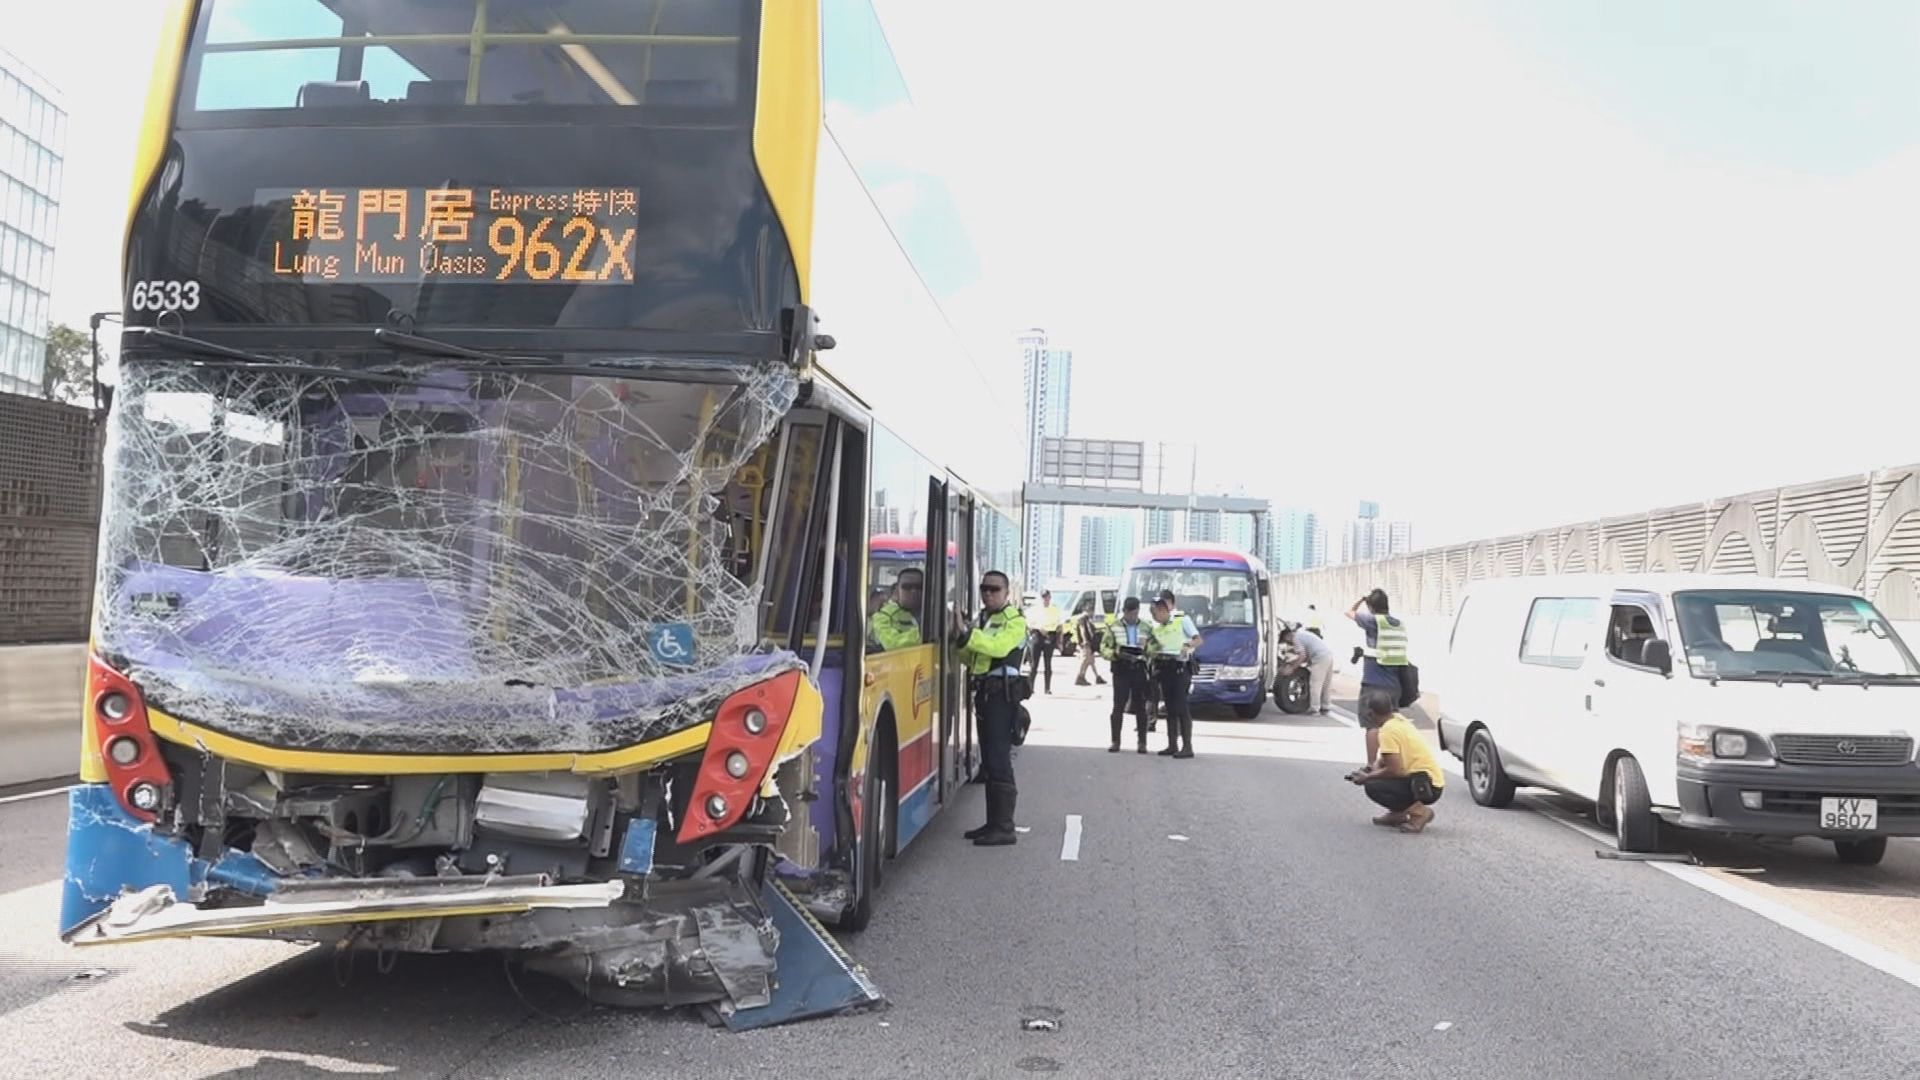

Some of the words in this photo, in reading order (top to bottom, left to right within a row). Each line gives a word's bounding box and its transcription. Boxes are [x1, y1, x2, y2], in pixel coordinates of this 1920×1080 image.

[290, 188, 475, 241] 龍門居
[489, 188, 569, 216] Express
[571, 188, 638, 216] 特快
[274, 240, 341, 279] Lung
[354, 240, 405, 275] Mun
[419, 241, 487, 275] Oasis
[487, 216, 637, 281] 962X
[132, 280, 200, 311] 6533
[1825, 812, 1873, 830] 9607
[1837, 798, 1861, 814] KV
